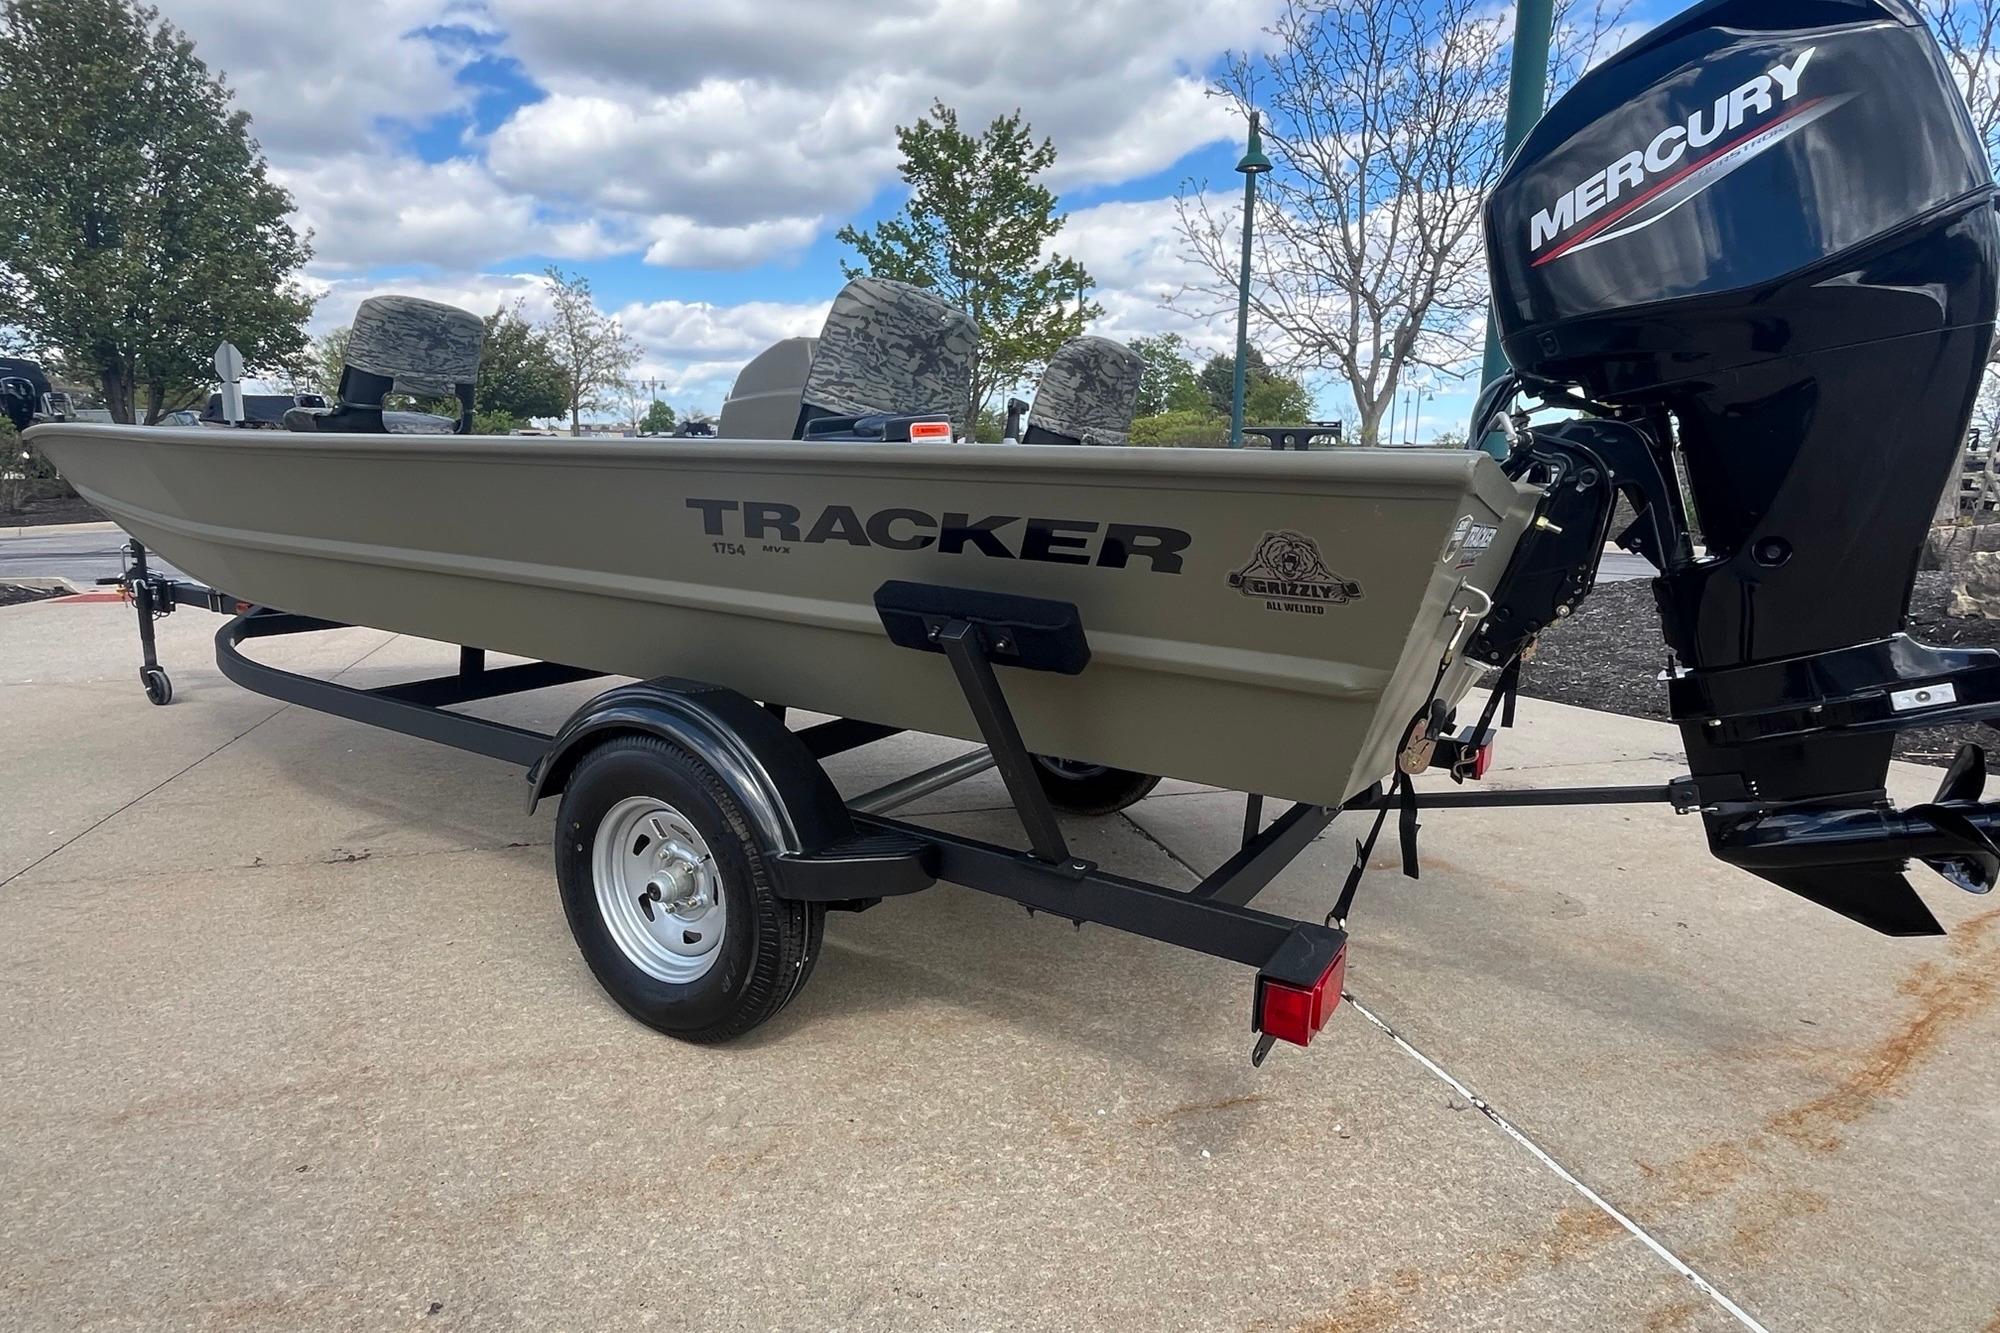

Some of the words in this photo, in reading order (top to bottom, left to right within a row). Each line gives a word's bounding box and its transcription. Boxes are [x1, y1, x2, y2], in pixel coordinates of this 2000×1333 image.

[1530, 46, 1817, 252] MERCURY
[685, 498, 1193, 575] TRACKER
[712, 542, 746, 556] 1754
[762, 545, 791, 554] MVX
[1252, 580, 1332, 598] GRIZZLY
[1266, 601, 1281, 611] ALL
[1283, 602, 1324, 615] WELDED
